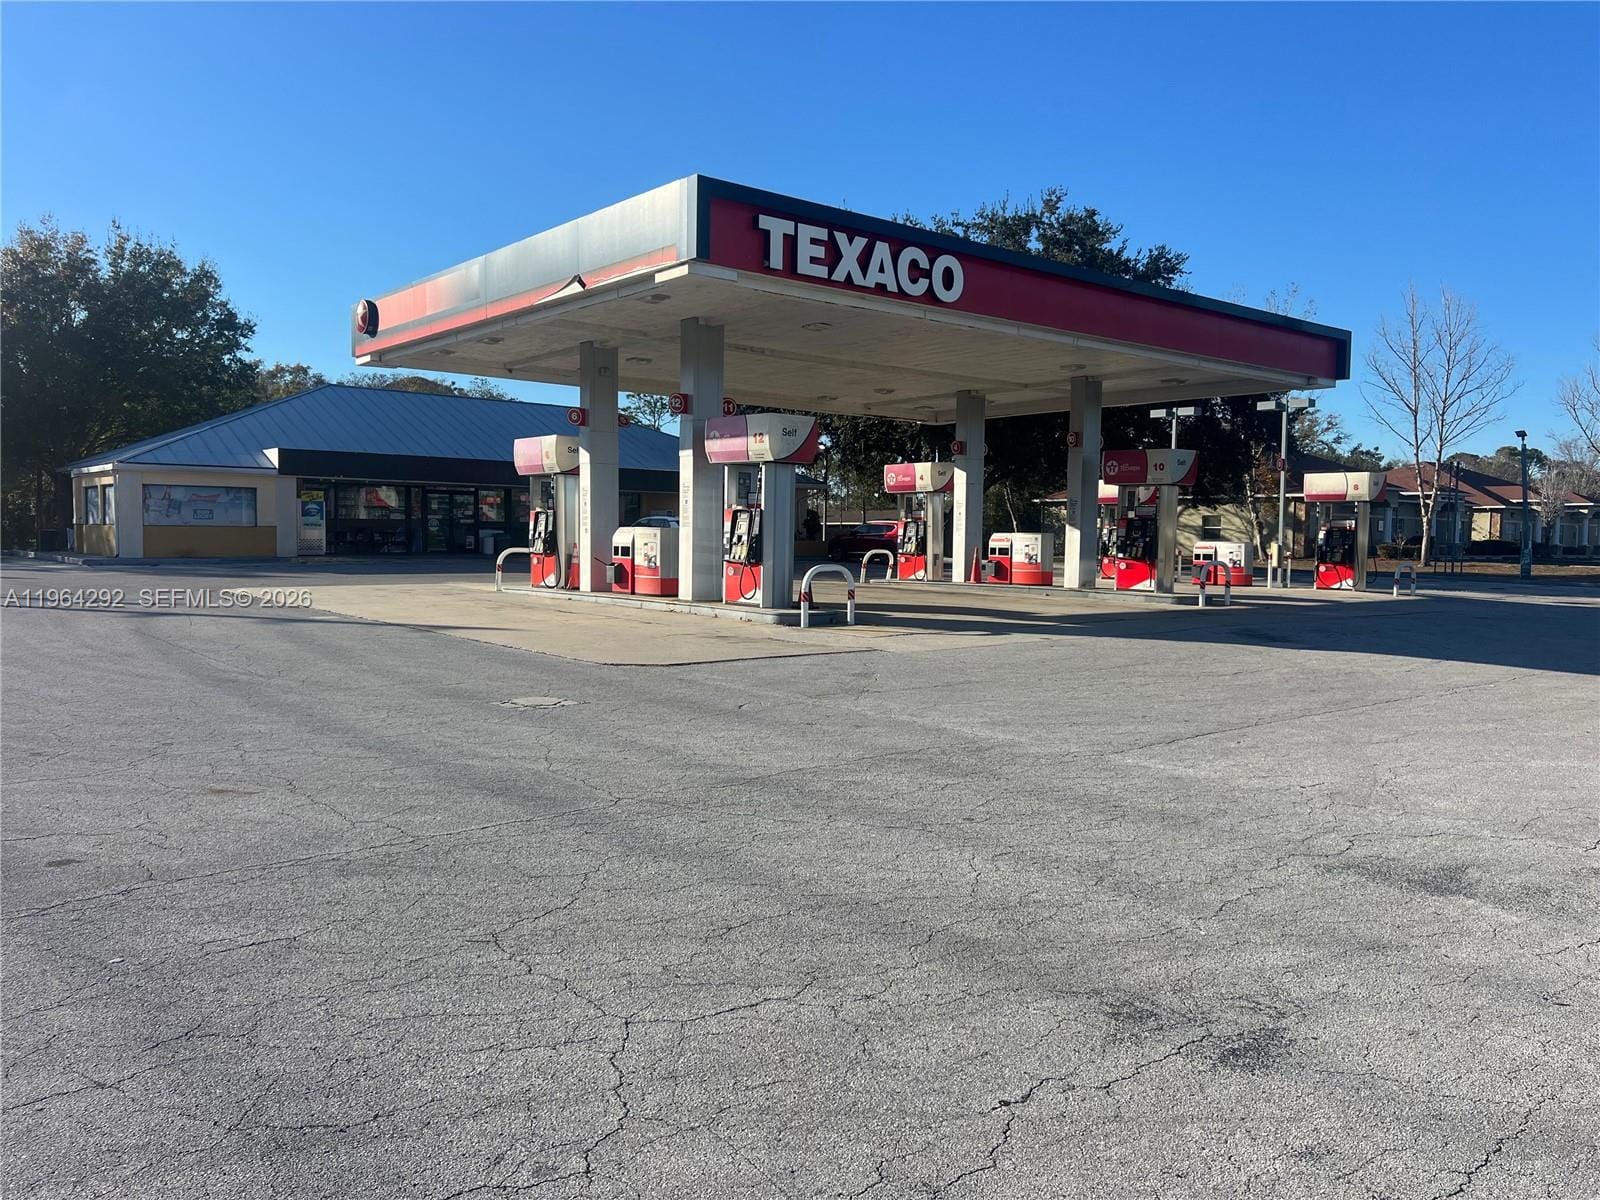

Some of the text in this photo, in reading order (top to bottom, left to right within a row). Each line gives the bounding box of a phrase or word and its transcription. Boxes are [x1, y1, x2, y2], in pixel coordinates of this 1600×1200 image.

[756, 213, 964, 304] TEXACO
[670, 398, 681, 408] 12
[724, 403, 733, 412] 11
[571, 412, 578, 420] 6
[782, 427, 798, 437] Self
[753, 432, 765, 444] 12
[567, 446, 580, 454] Sel
[1153, 462, 1165, 472] 10
